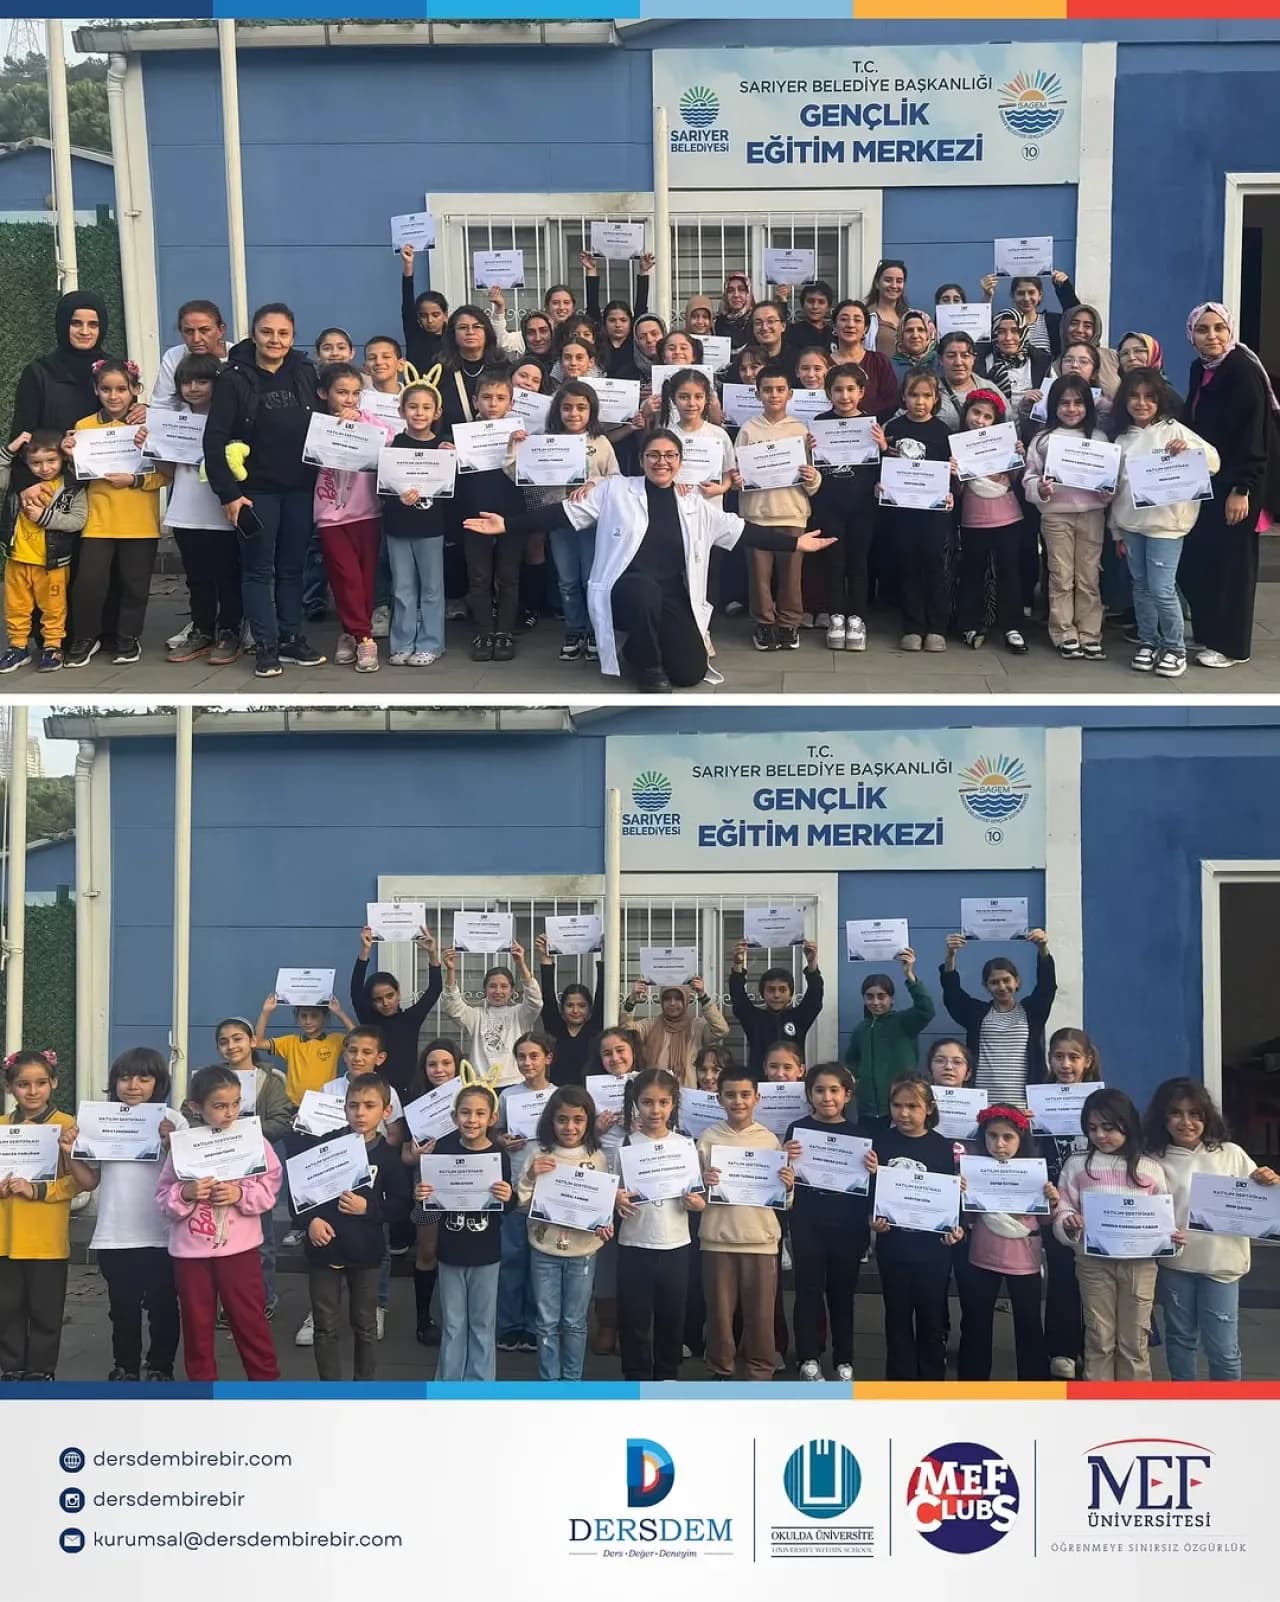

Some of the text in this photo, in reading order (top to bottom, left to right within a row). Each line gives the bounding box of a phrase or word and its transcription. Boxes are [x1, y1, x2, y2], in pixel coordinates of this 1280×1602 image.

[852, 61, 878, 74] T.C.
[739, 73, 993, 94] SARIYER BELEDİYE BAŞKANLIĞI
[800, 97, 930, 132] GENÇLİK
[671, 129, 729, 142] SARIYER
[671, 142, 729, 153] BELEDİYESİ
[746, 132, 983, 164] EĞİTİM MERKEZİ
[1024, 146, 1038, 158] 10
[807, 745, 833, 759] T.C.
[692, 758, 953, 779] SARIYER BELEDİYE BAŞKANLIĞI
[753, 782, 887, 818] GENÇLİK
[622, 813, 681, 825] SARIYER
[622, 825, 681, 836] BELEDİYESİ
[698, 816, 944, 847] EĞİTİM MERKEZİ
[988, 831, 1002, 842] 10
